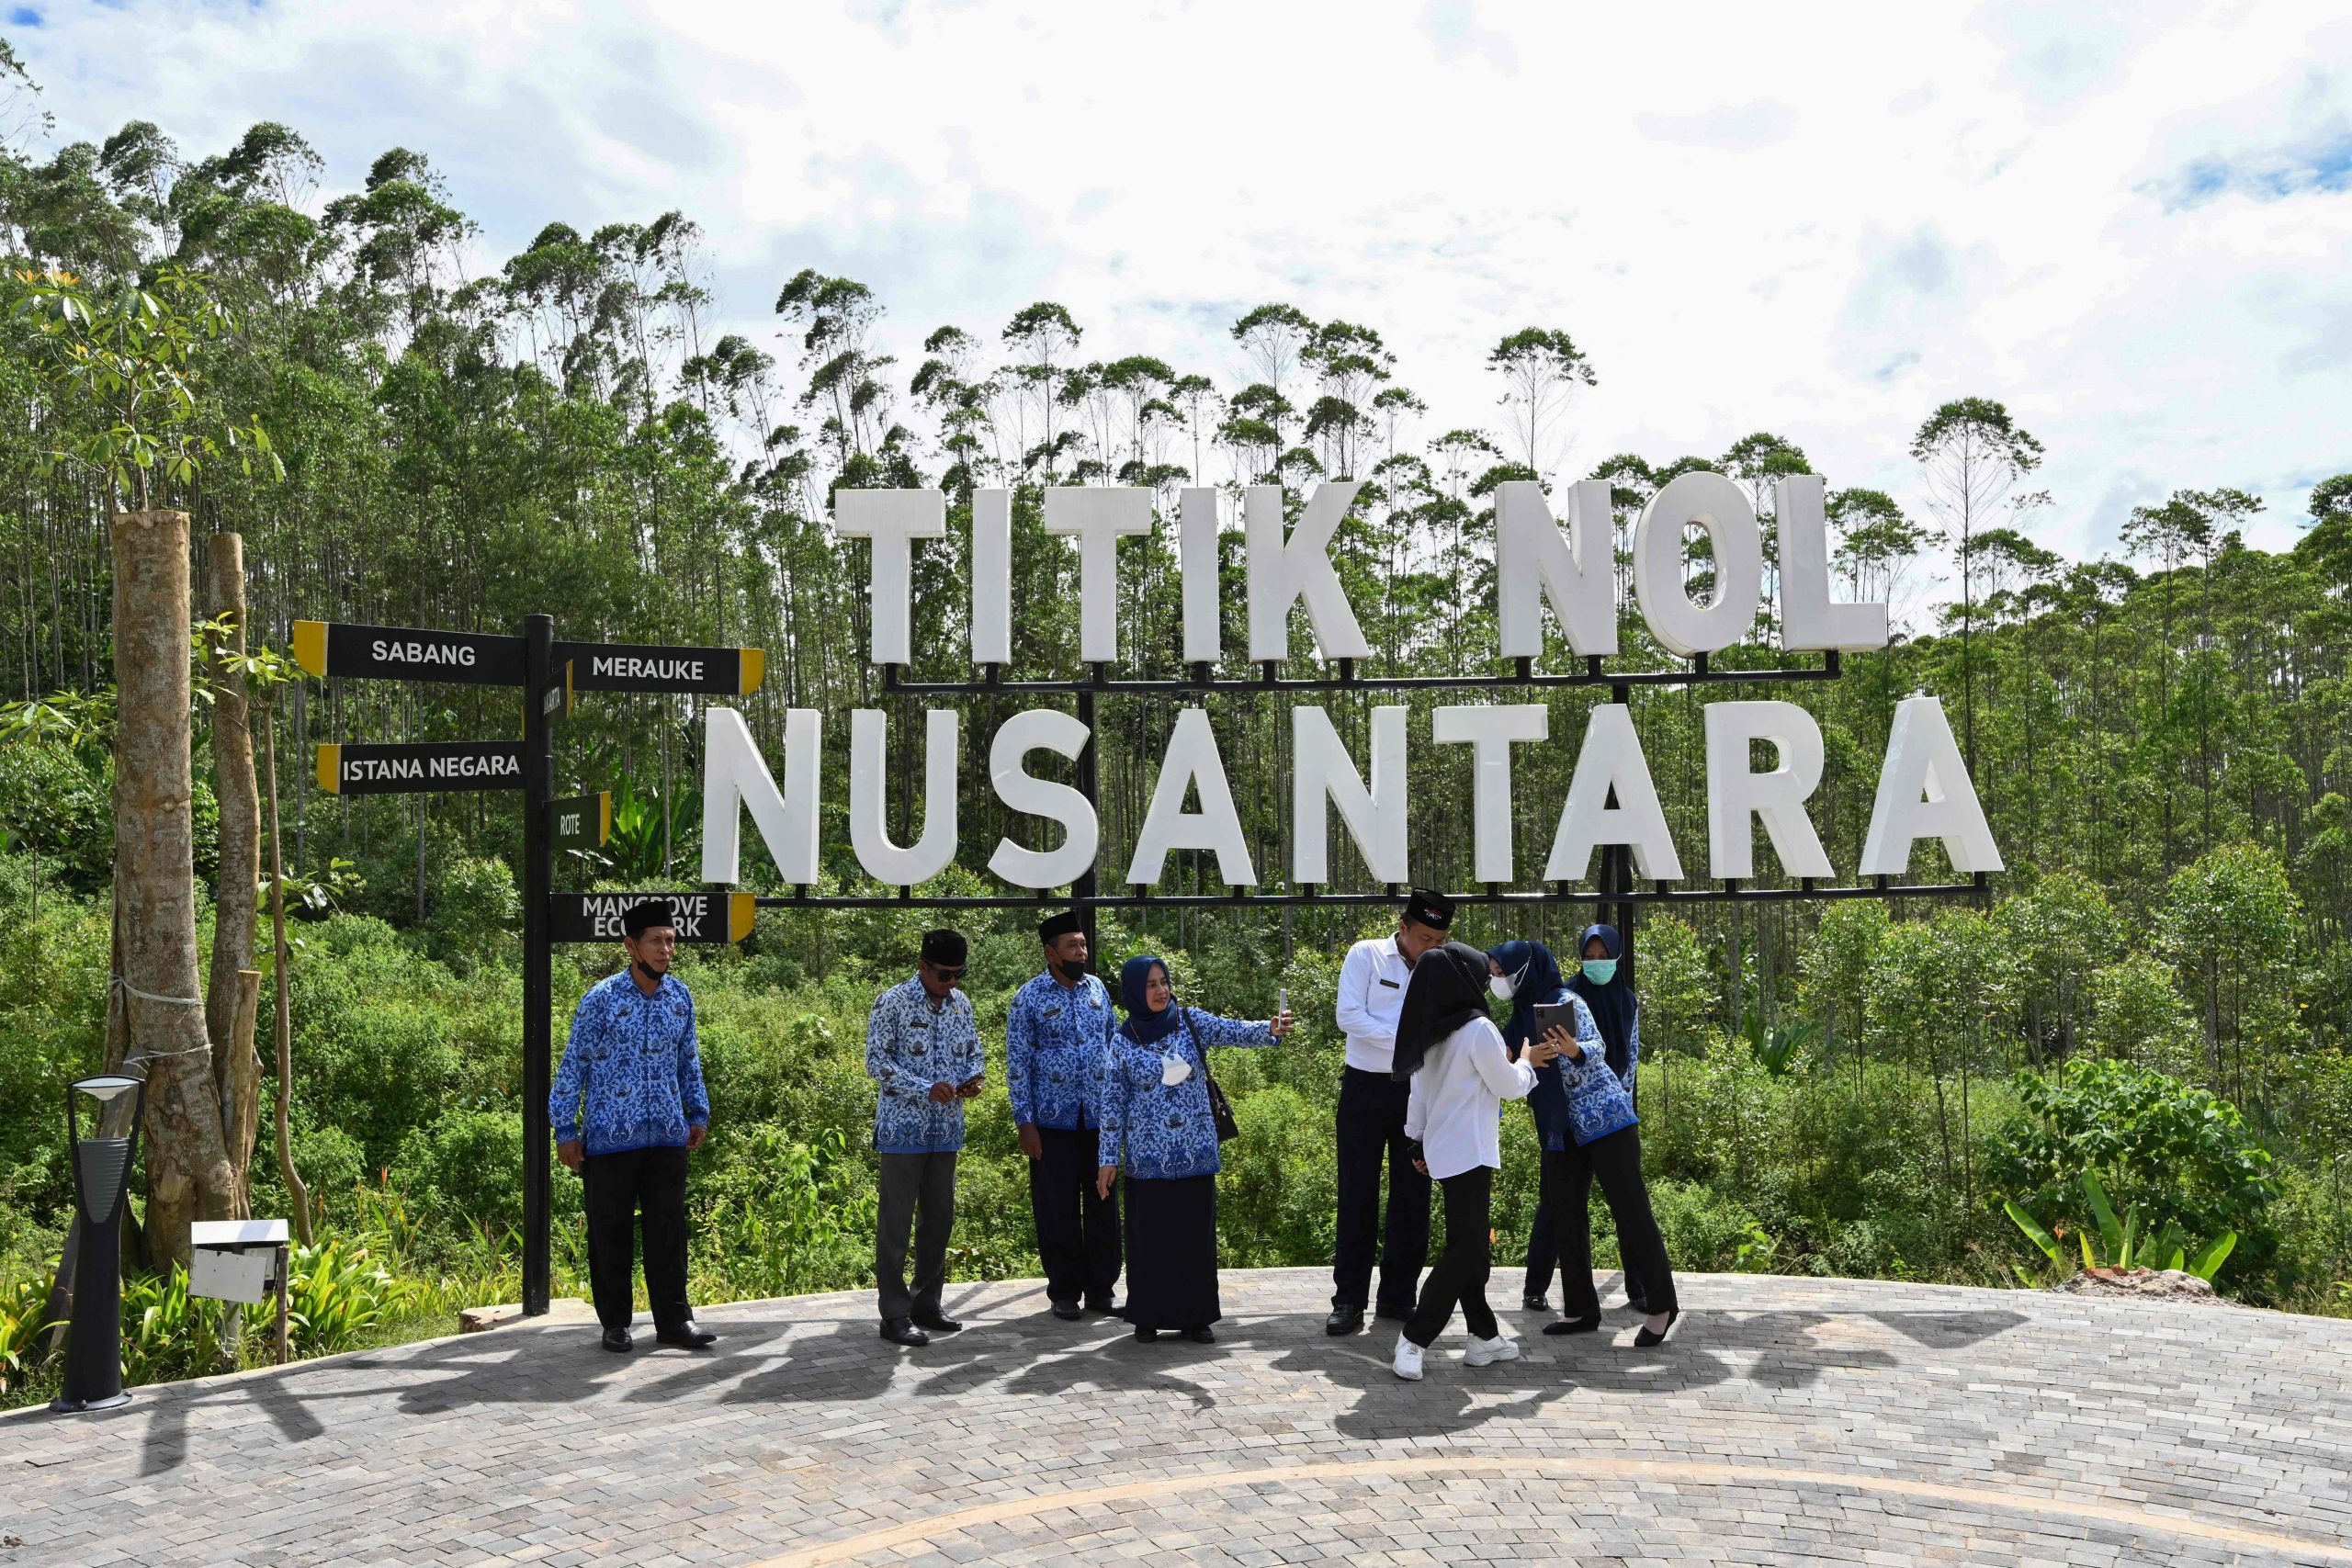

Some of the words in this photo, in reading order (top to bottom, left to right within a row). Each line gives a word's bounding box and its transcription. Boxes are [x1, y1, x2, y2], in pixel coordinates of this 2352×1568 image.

[835, 481, 1372, 665] TITIK
[1495, 471, 1888, 660] NOL
[371, 640, 476, 666] SABANG
[593, 656, 704, 680] MERAUKE
[343, 758, 424, 781] ISTANA
[430, 755, 520, 778] NEGARA
[701, 696, 2005, 889] NUSANTARA
[560, 813, 581, 836] ROTE
[582, 896, 707, 917] MANOVE
